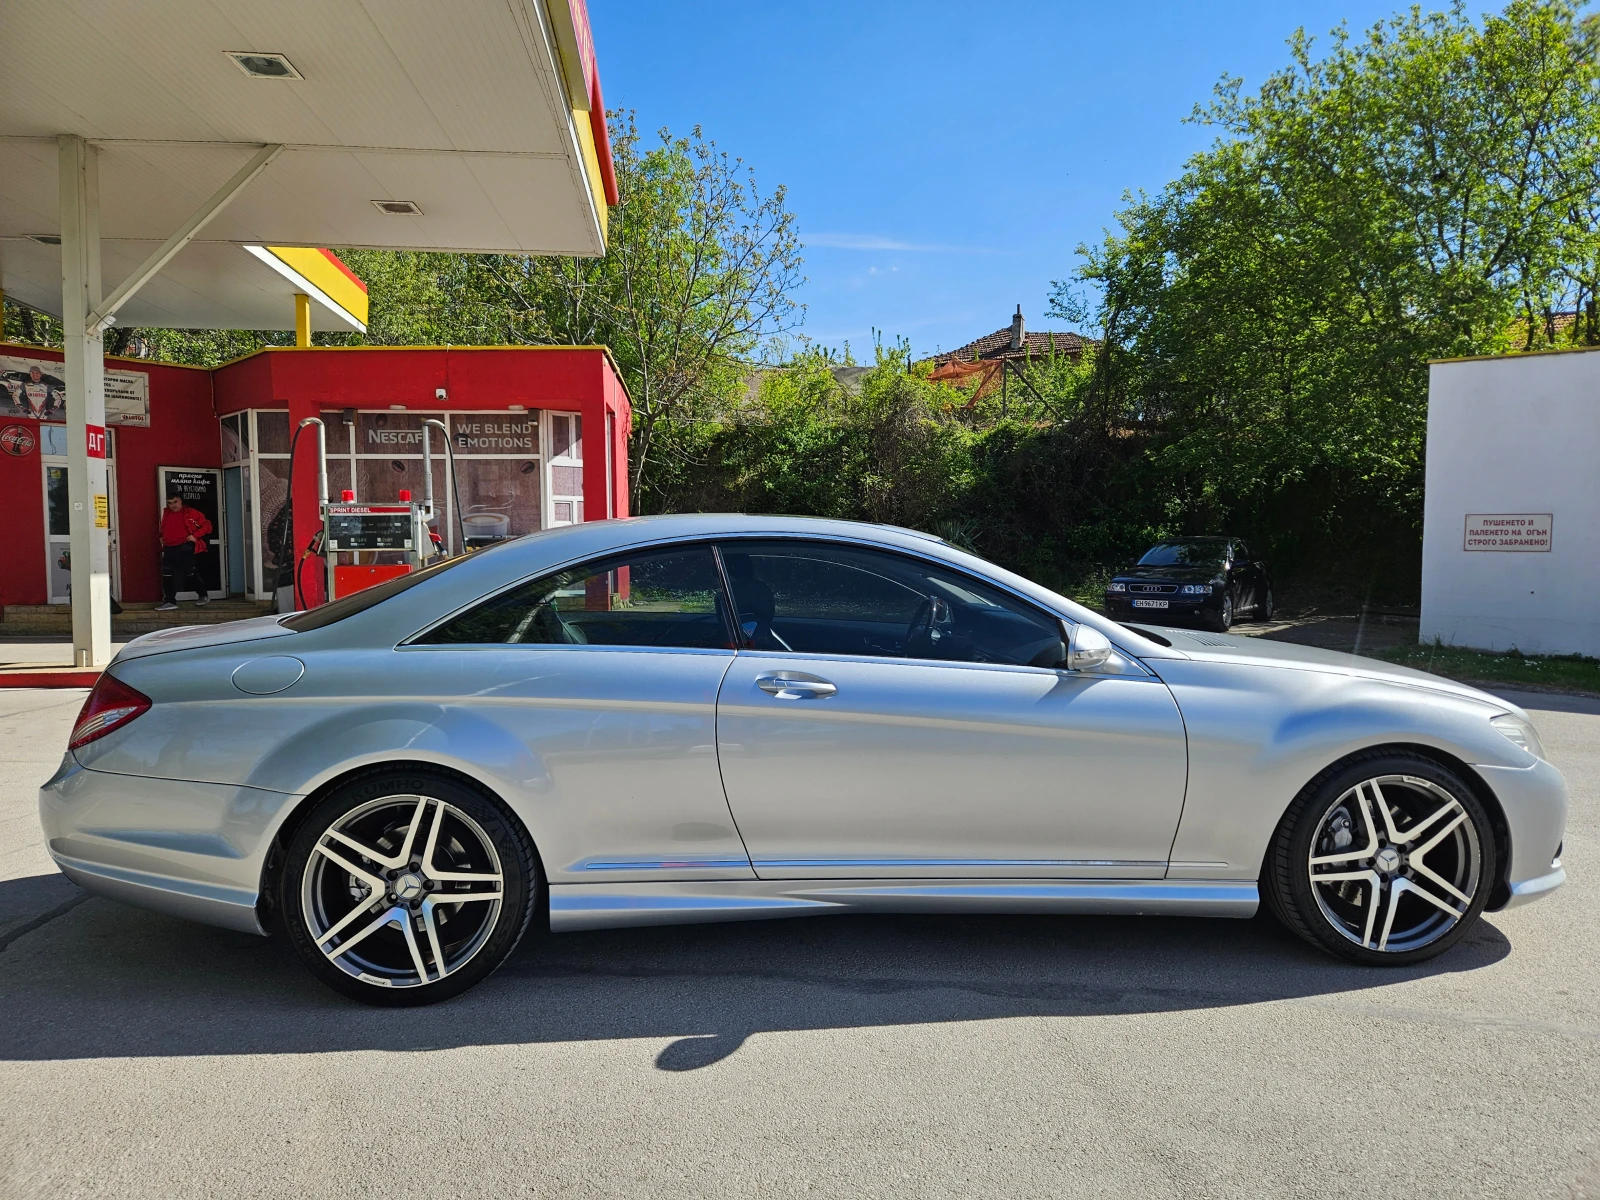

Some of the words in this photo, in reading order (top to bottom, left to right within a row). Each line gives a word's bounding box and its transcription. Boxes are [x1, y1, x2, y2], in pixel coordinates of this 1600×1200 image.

[457, 424, 480, 434] WE
[484, 424, 532, 434] BLEND
[368, 429, 423, 444] NESCAF
[458, 438, 532, 448] EMOTIONS
[352, 780, 424, 801] KUMHO
